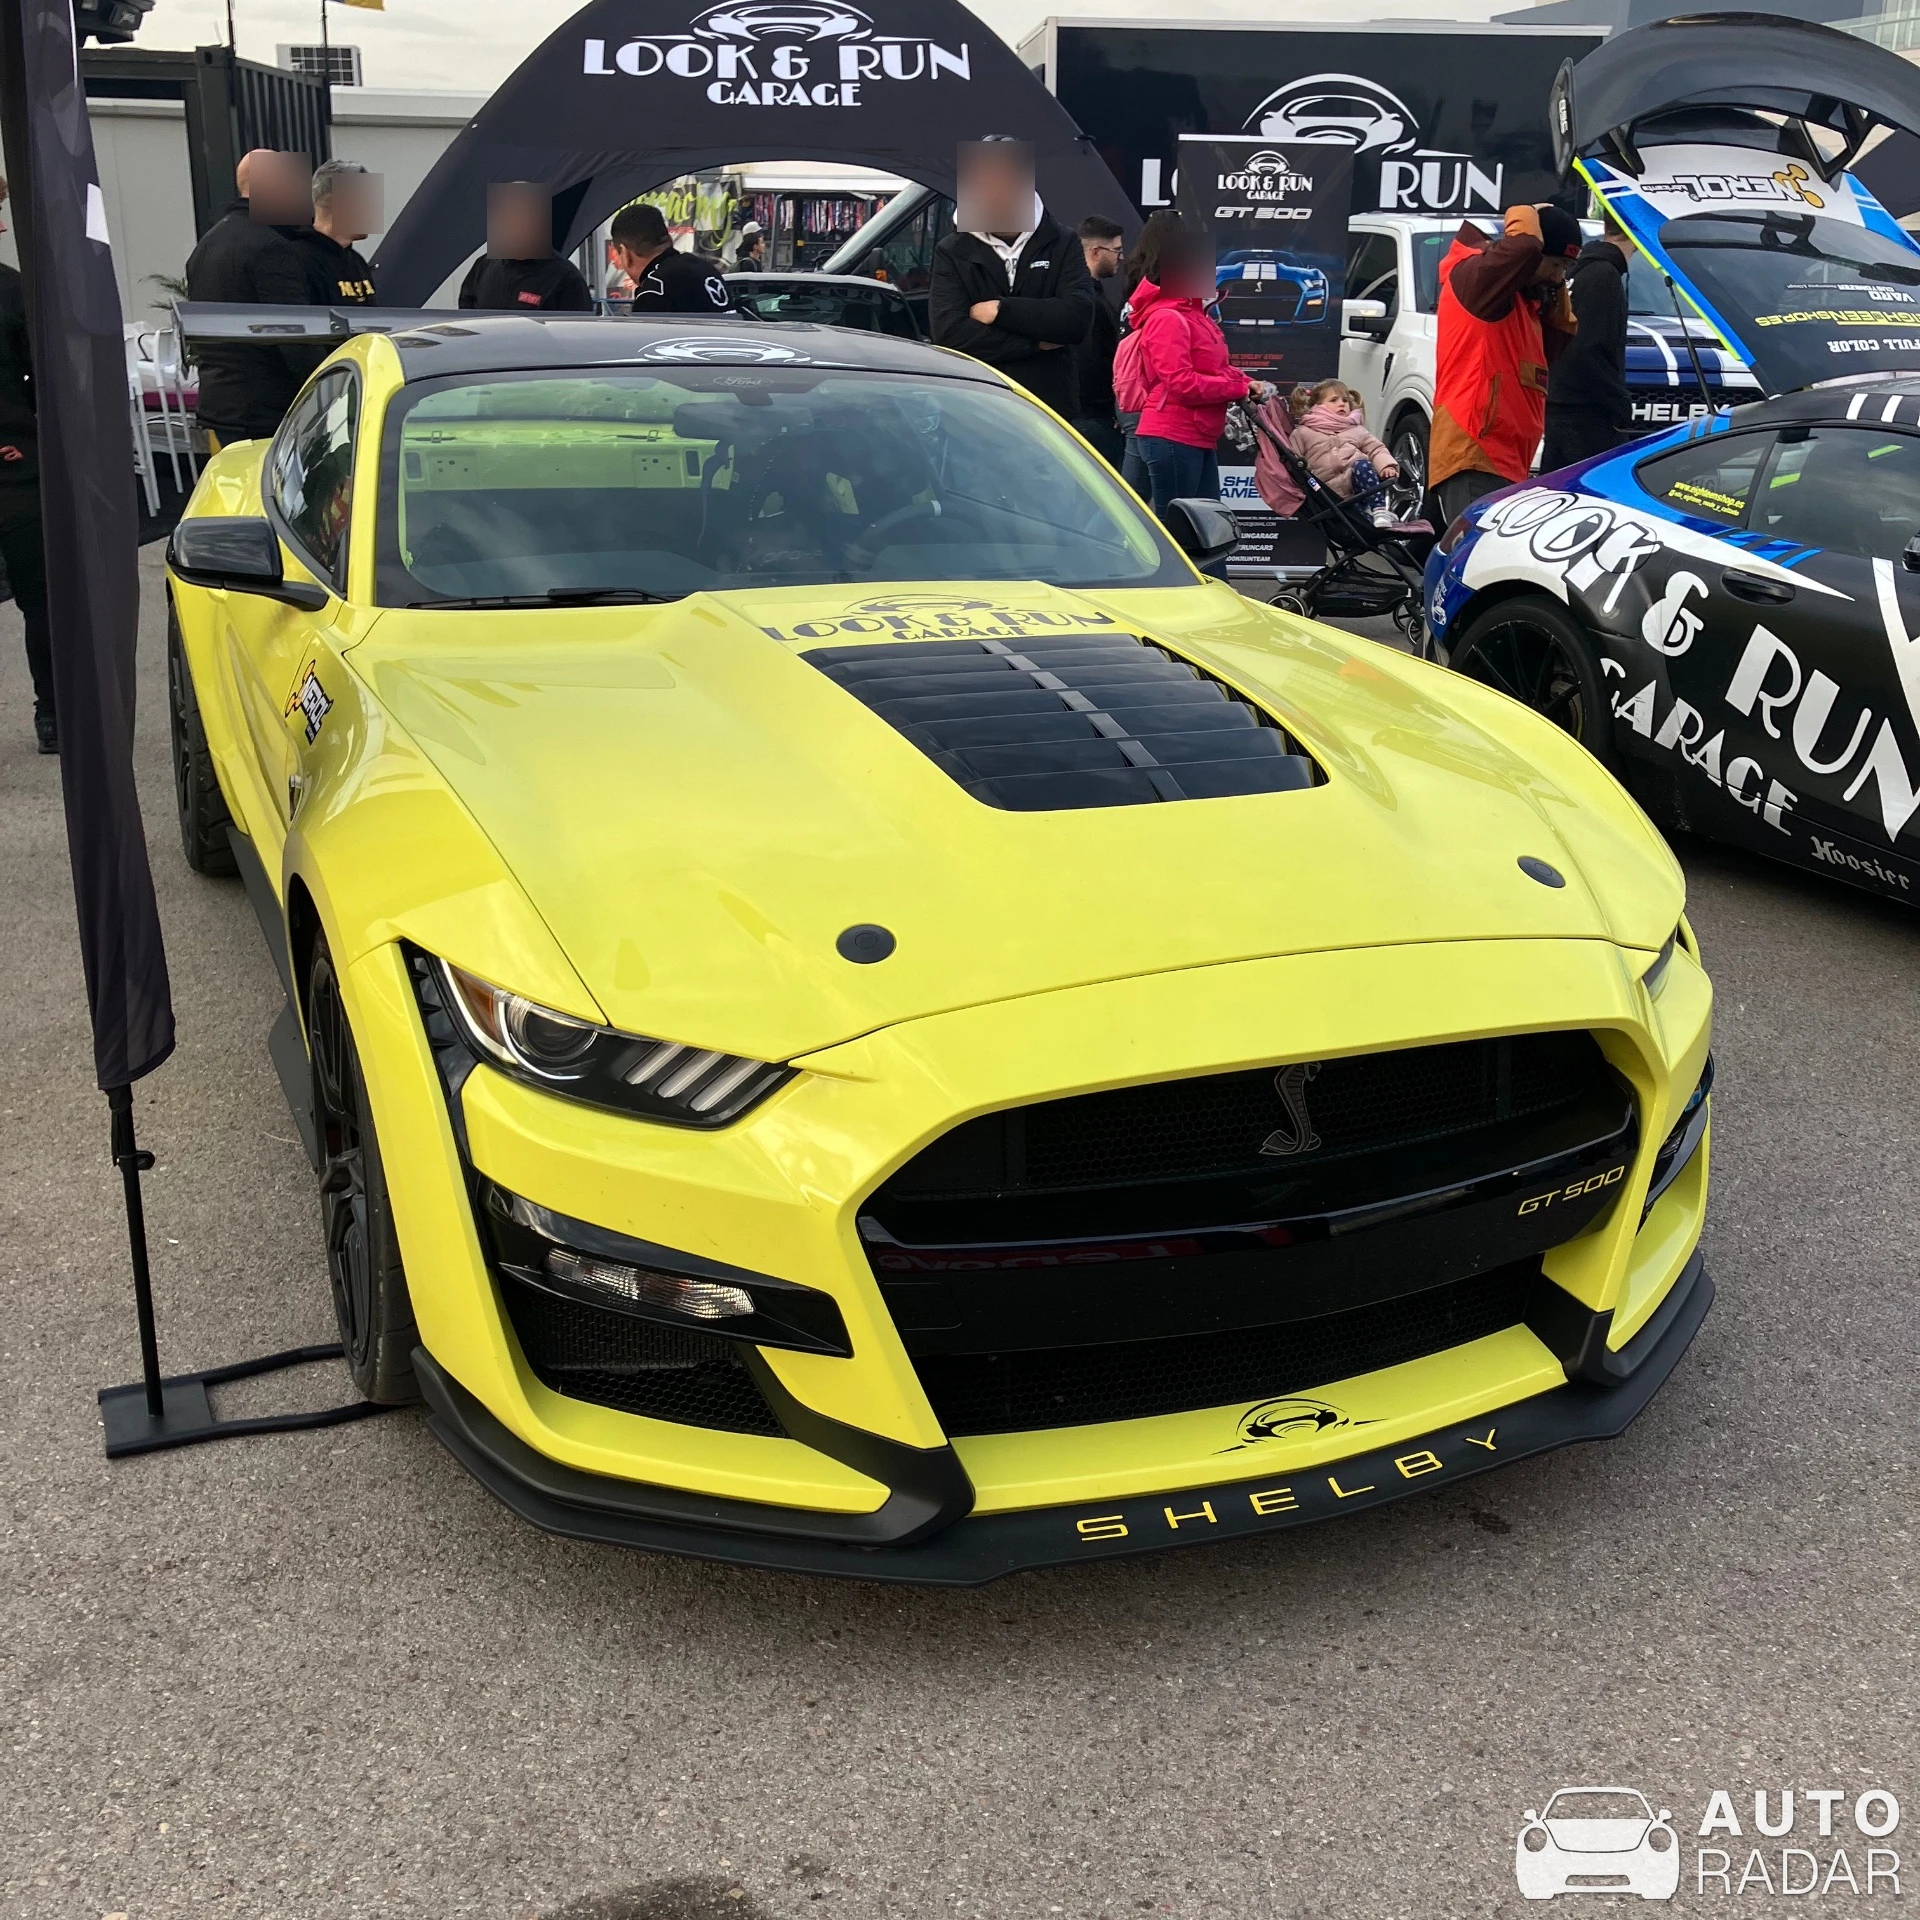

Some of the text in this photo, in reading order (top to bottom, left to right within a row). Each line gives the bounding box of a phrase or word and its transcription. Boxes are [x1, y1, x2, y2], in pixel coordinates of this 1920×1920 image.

[583, 39, 970, 81] LOOK & RUN
[706, 81, 862, 106] GARAGE
[1217, 174, 1313, 192] LOOK & RUN
[1246, 190, 1285, 201] GARAGE
[1379, 161, 1503, 211] RUN
[1672, 175, 1804, 202] NEROL
[1214, 206, 1313, 220] GT 500
[1826, 339, 1881, 353] COLOR
[1220, 487, 1262, 499] AME
[1476, 487, 1661, 613] LOOK
[1642, 571, 1709, 657] &
[759, 609, 1117, 643] LOOK & RUN
[892, 624, 1035, 642] GARAGE
[1600, 658, 1799, 836] GARAGE
[1810, 835, 1911, 891] Hoosier
[1517, 1165, 1626, 1217] GT 500
[1076, 1427, 1500, 1543] SHELBY
